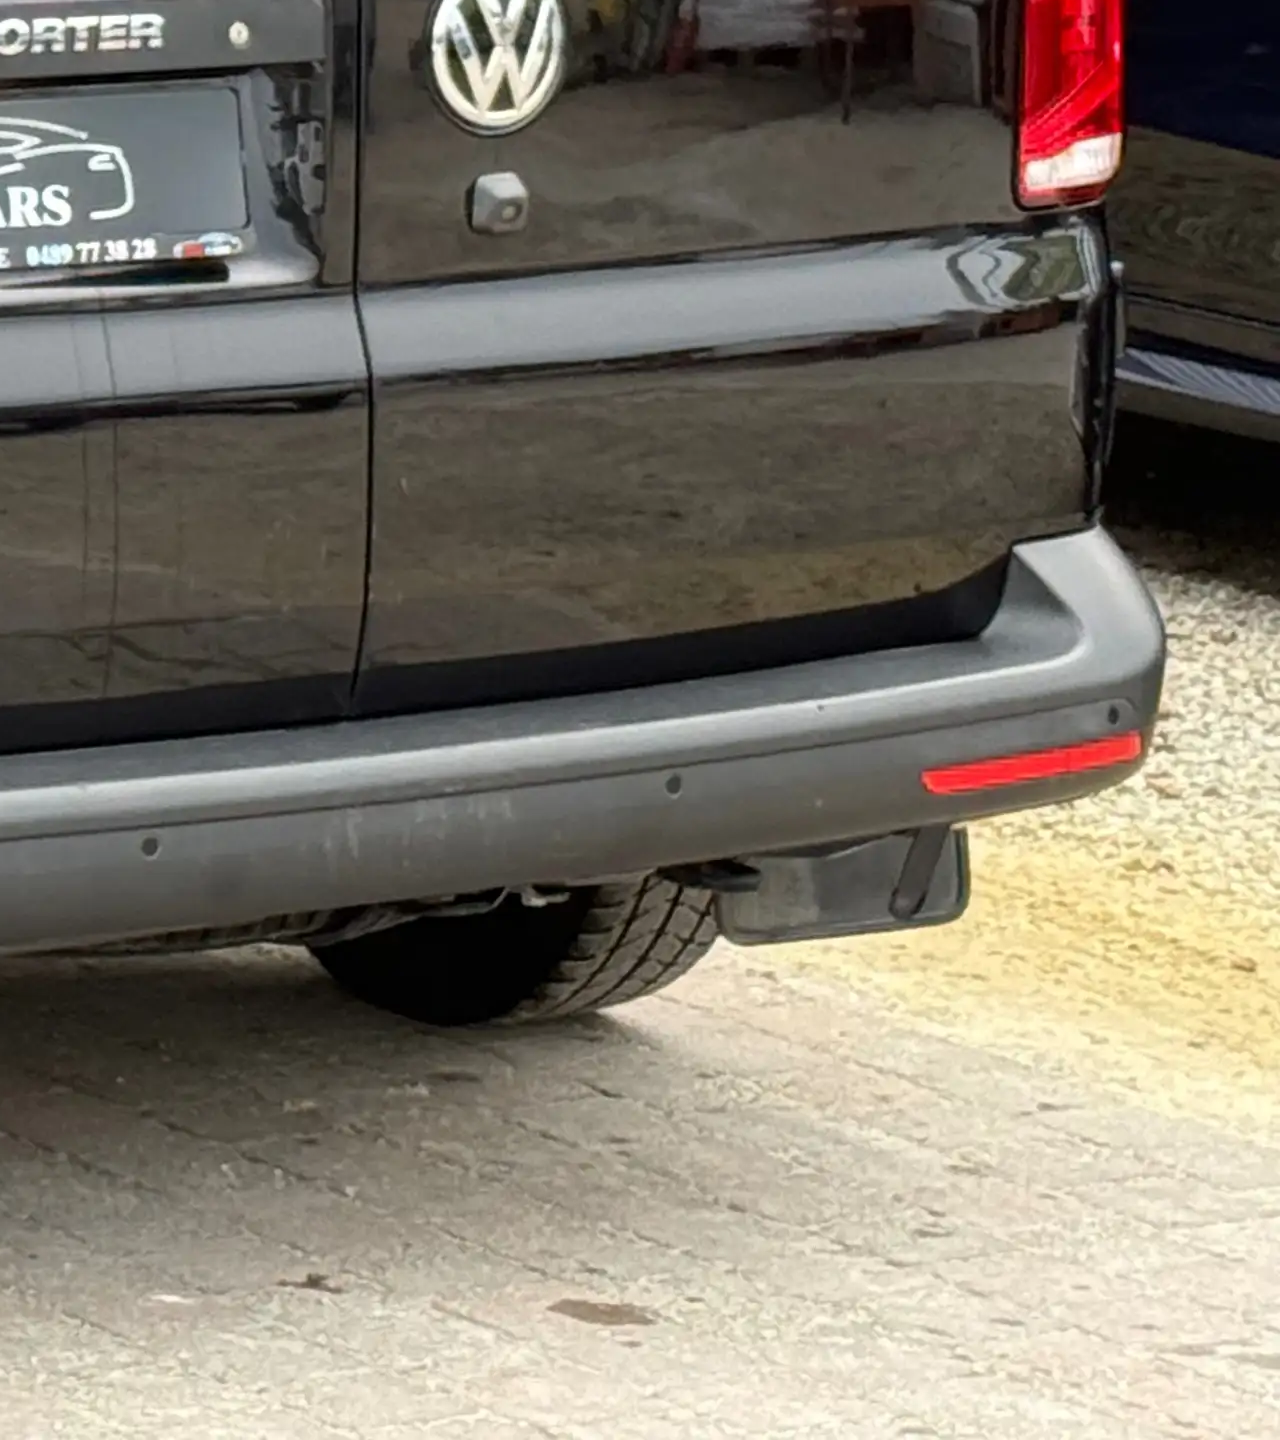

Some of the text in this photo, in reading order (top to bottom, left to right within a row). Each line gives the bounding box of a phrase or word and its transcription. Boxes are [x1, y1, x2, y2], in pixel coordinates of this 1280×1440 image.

[75, 241, 101, 264] 77
[103, 239, 130, 262] 38
[131, 237, 158, 261] 28
